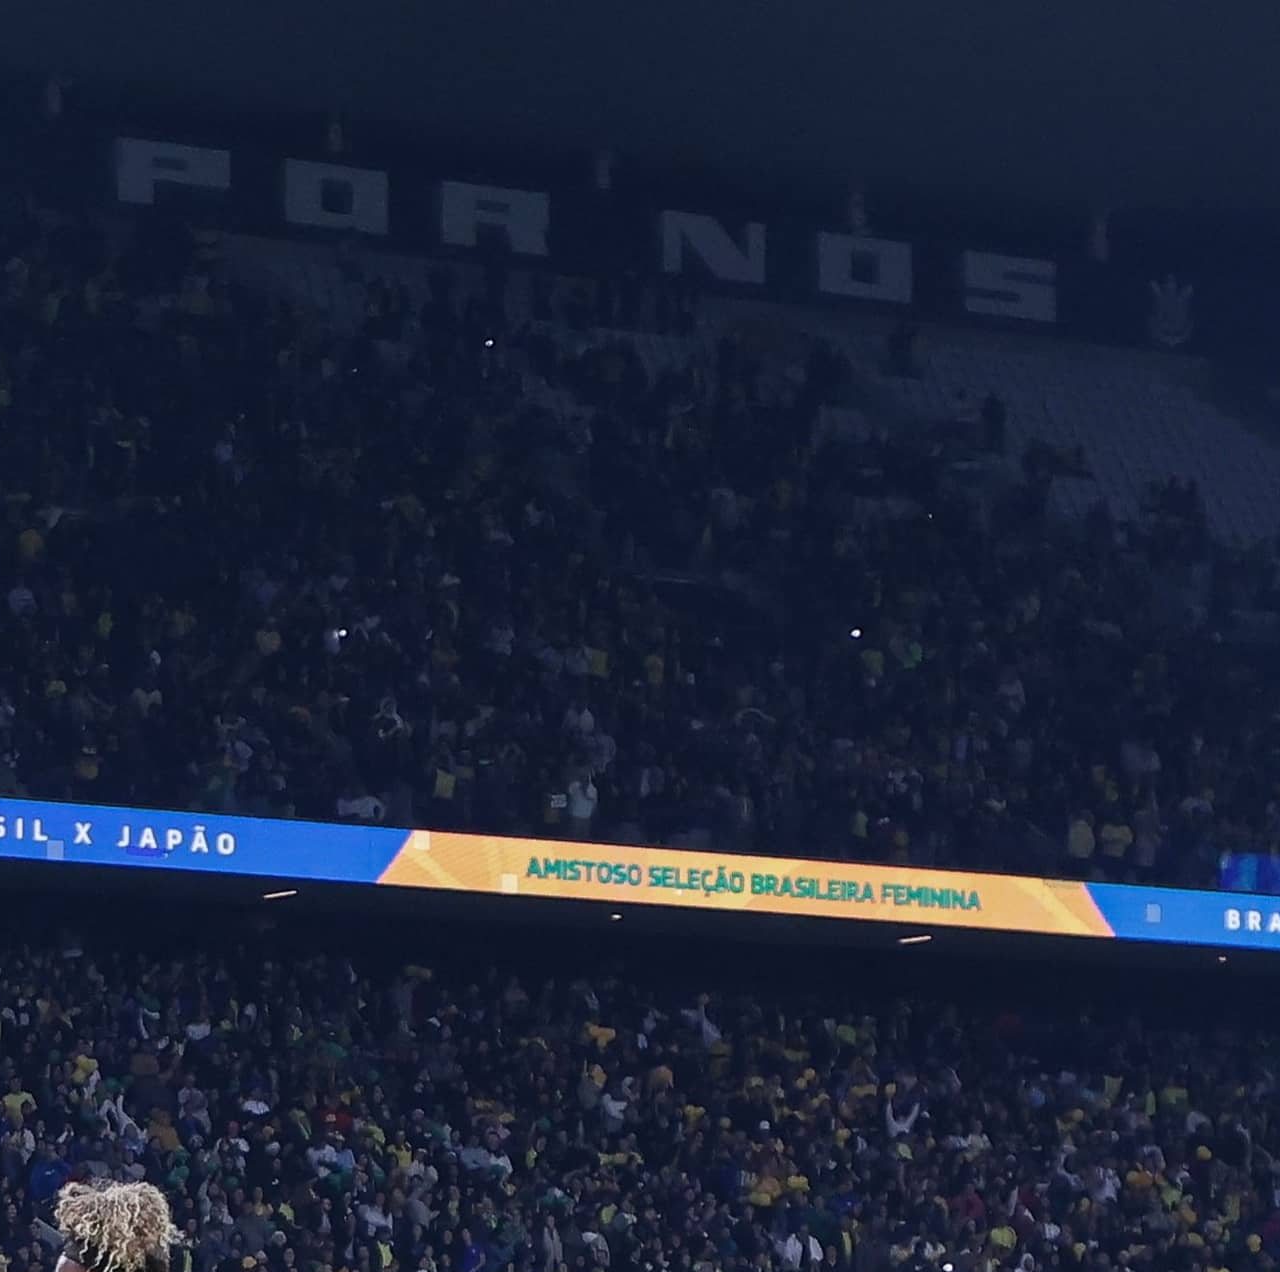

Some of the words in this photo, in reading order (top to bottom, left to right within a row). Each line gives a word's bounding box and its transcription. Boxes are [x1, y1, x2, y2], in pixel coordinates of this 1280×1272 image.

[117, 136, 551, 256] POR
[74, 821, 93, 846] X
[116, 824, 236, 856] JAPÃO
[526, 856, 642, 887] AMISTOSO
[648, 864, 745, 899] SELEÇÃO
[751, 874, 875, 904] BRASILEIRA
[881, 883, 982, 912] FEMININA
